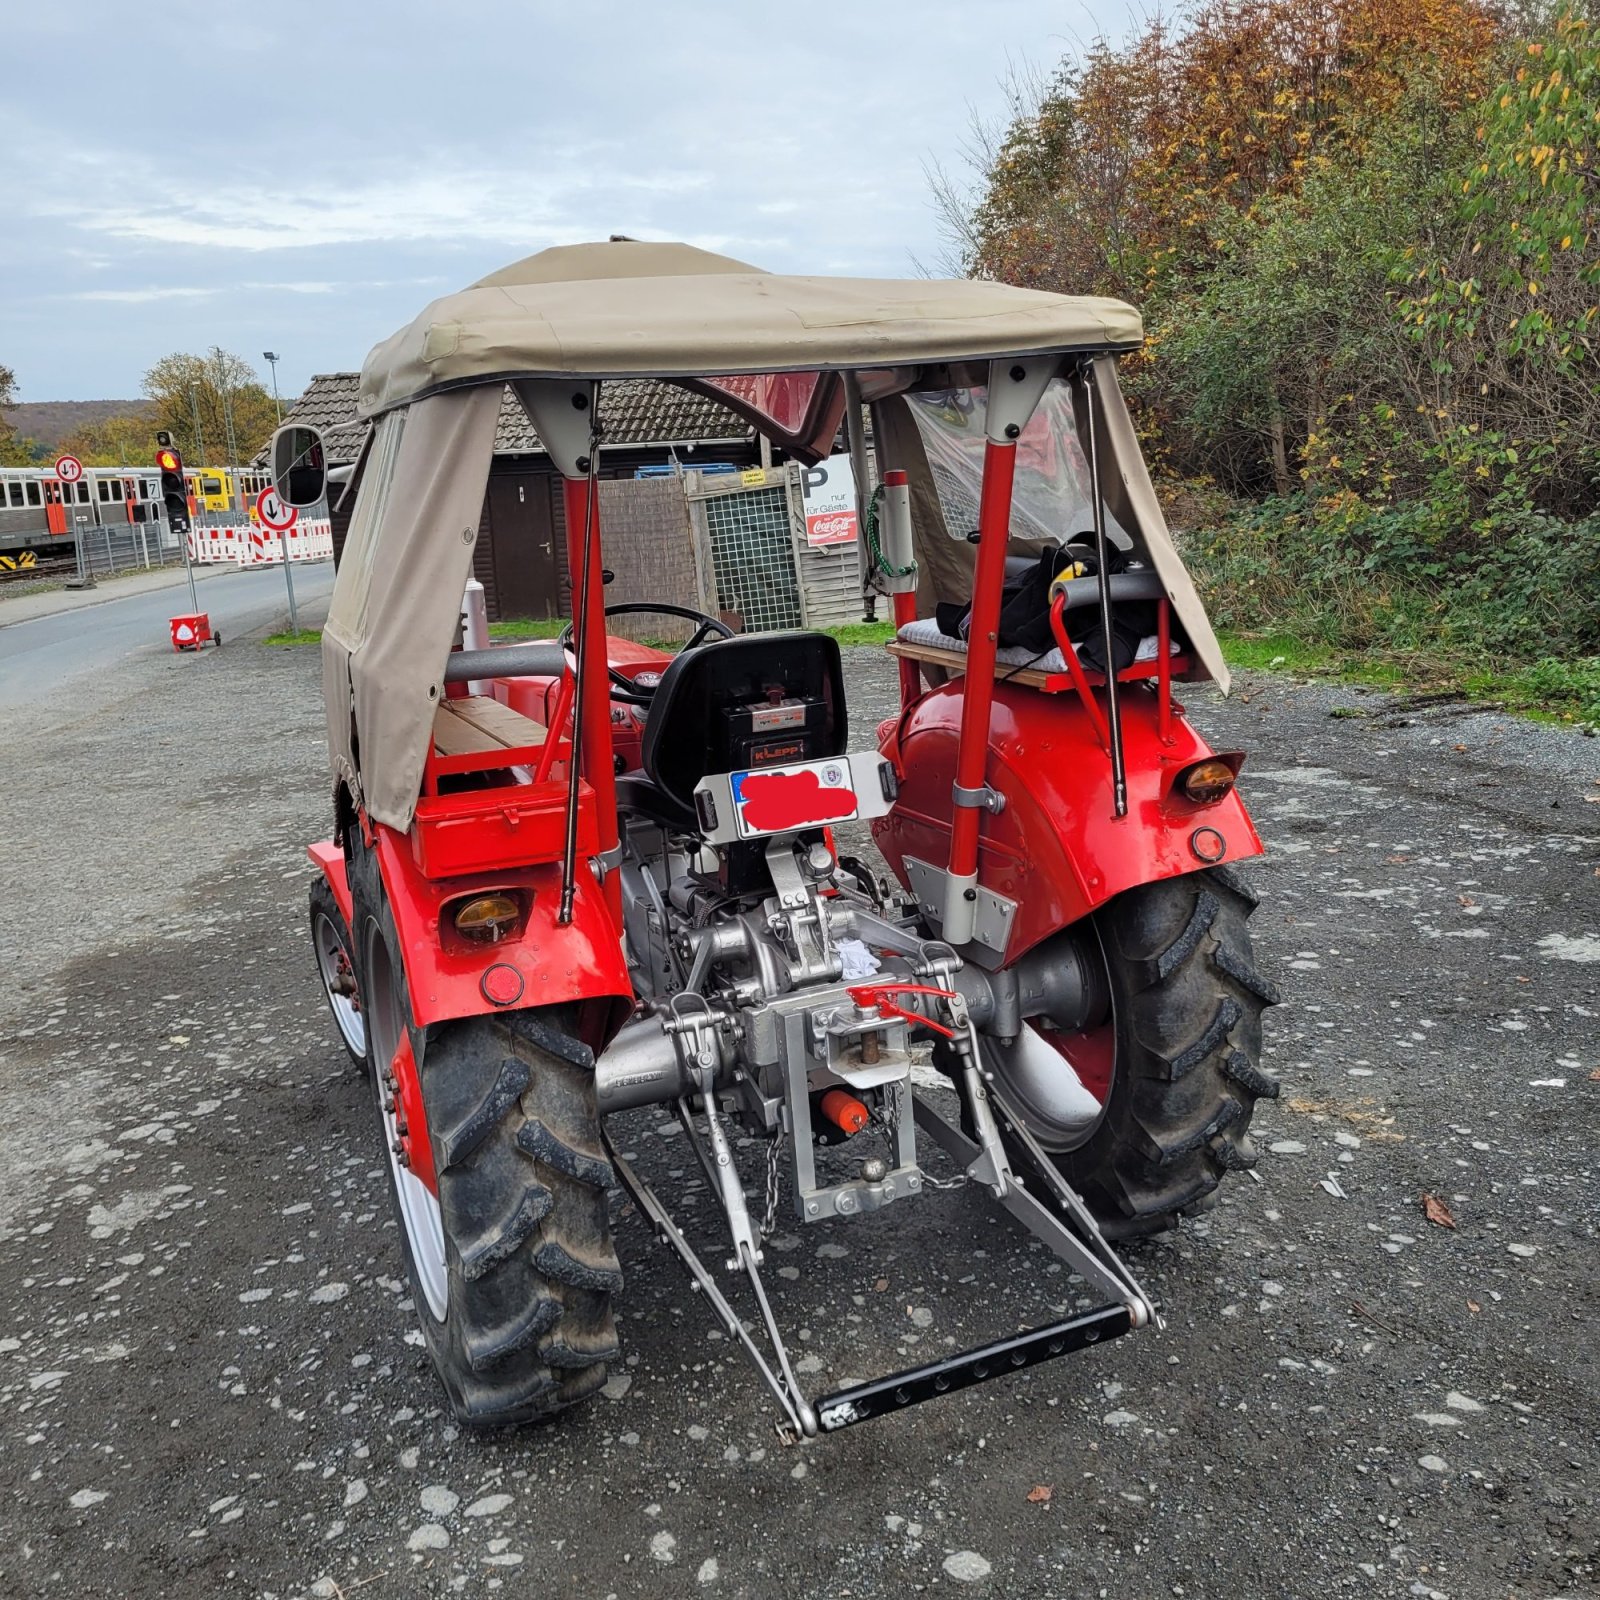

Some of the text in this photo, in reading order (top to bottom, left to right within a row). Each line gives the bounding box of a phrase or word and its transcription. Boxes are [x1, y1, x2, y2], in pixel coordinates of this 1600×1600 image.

[801, 467, 828, 498] P
[149, 483, 156, 495] 7
[831, 493, 846, 501] nur
[806, 504, 848, 515] für Gäste
